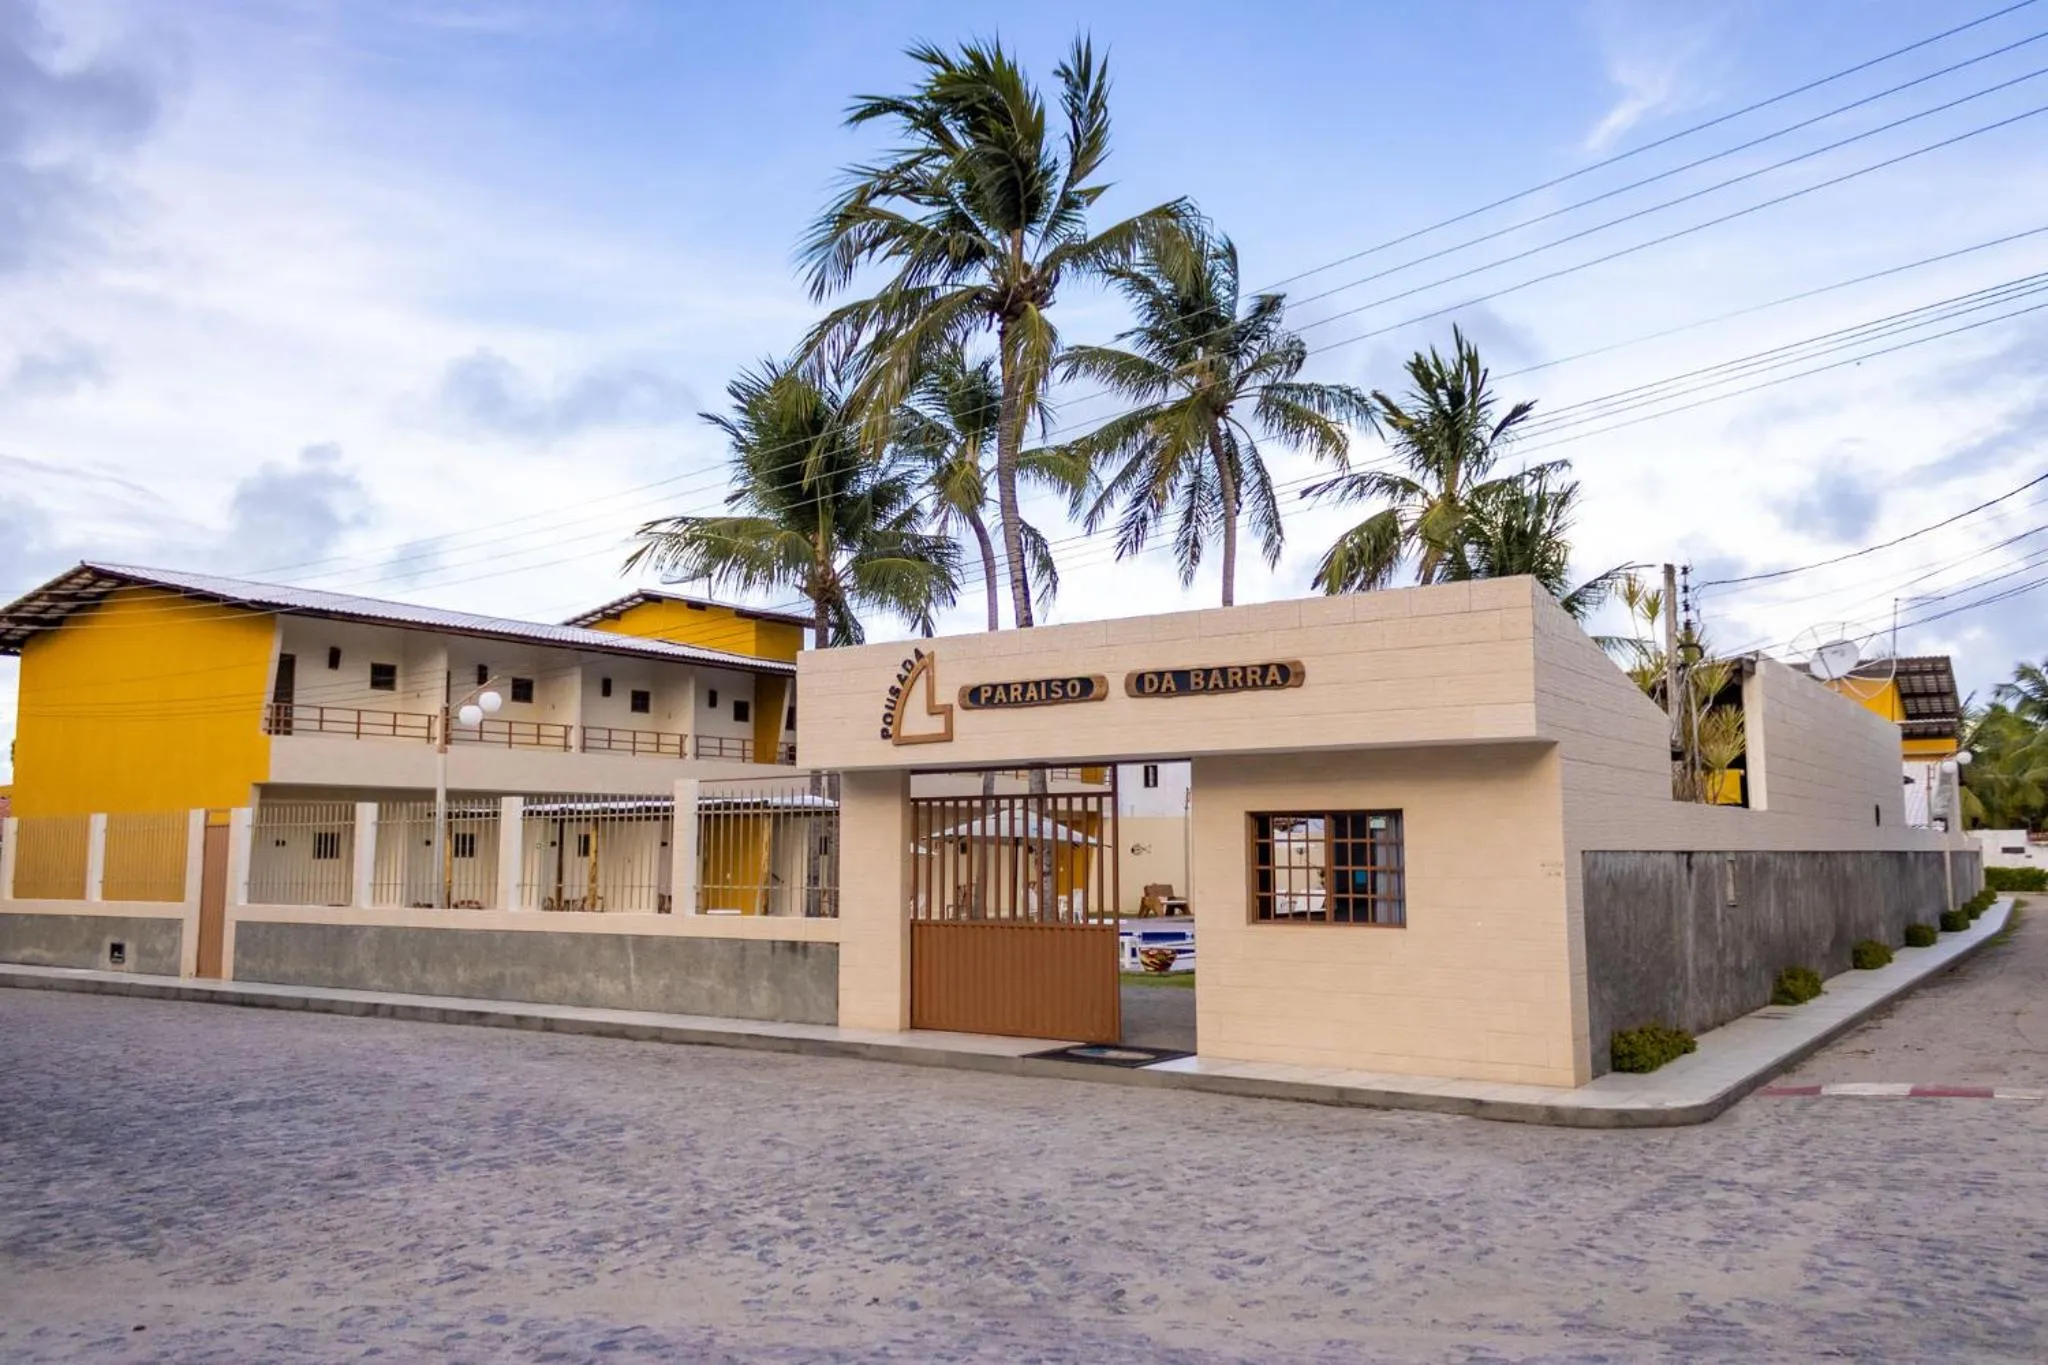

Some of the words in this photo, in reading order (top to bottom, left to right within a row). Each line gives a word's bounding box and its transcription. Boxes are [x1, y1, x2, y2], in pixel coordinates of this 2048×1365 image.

[980, 679, 1081, 705] PARAISO
[1143, 672, 1177, 693] DA
[1189, 664, 1283, 691] BARRA
[880, 647, 925, 740] POUSADA
